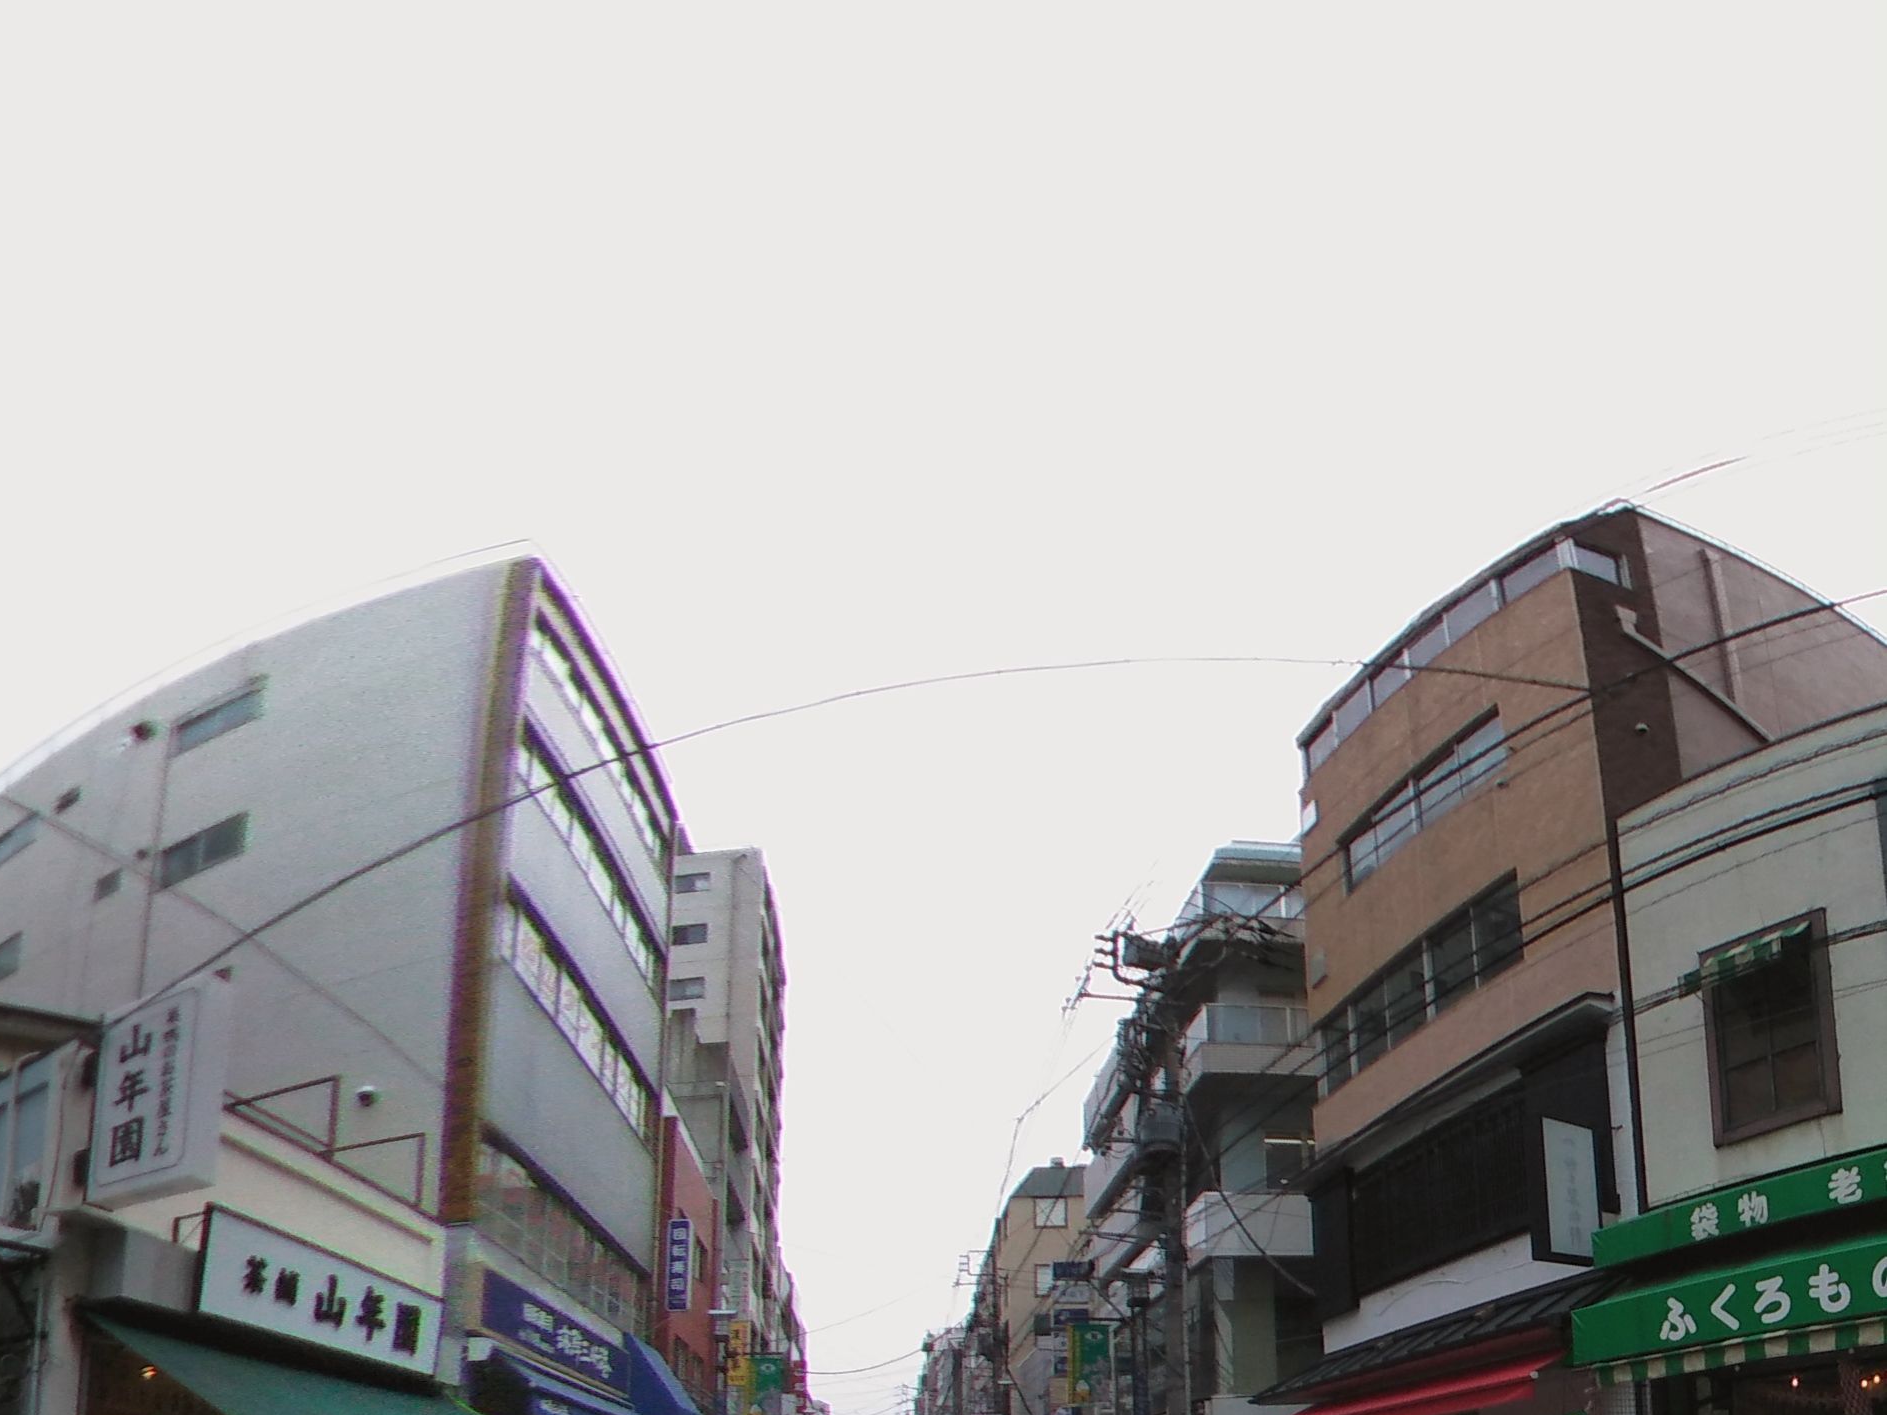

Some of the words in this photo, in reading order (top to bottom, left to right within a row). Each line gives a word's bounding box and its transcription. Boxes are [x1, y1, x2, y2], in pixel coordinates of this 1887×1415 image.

[108, 1023, 155, 1168] 山年園
[1689, 1190, 1769, 1241] 袋物
[313, 1272, 423, 1357] 山年園
